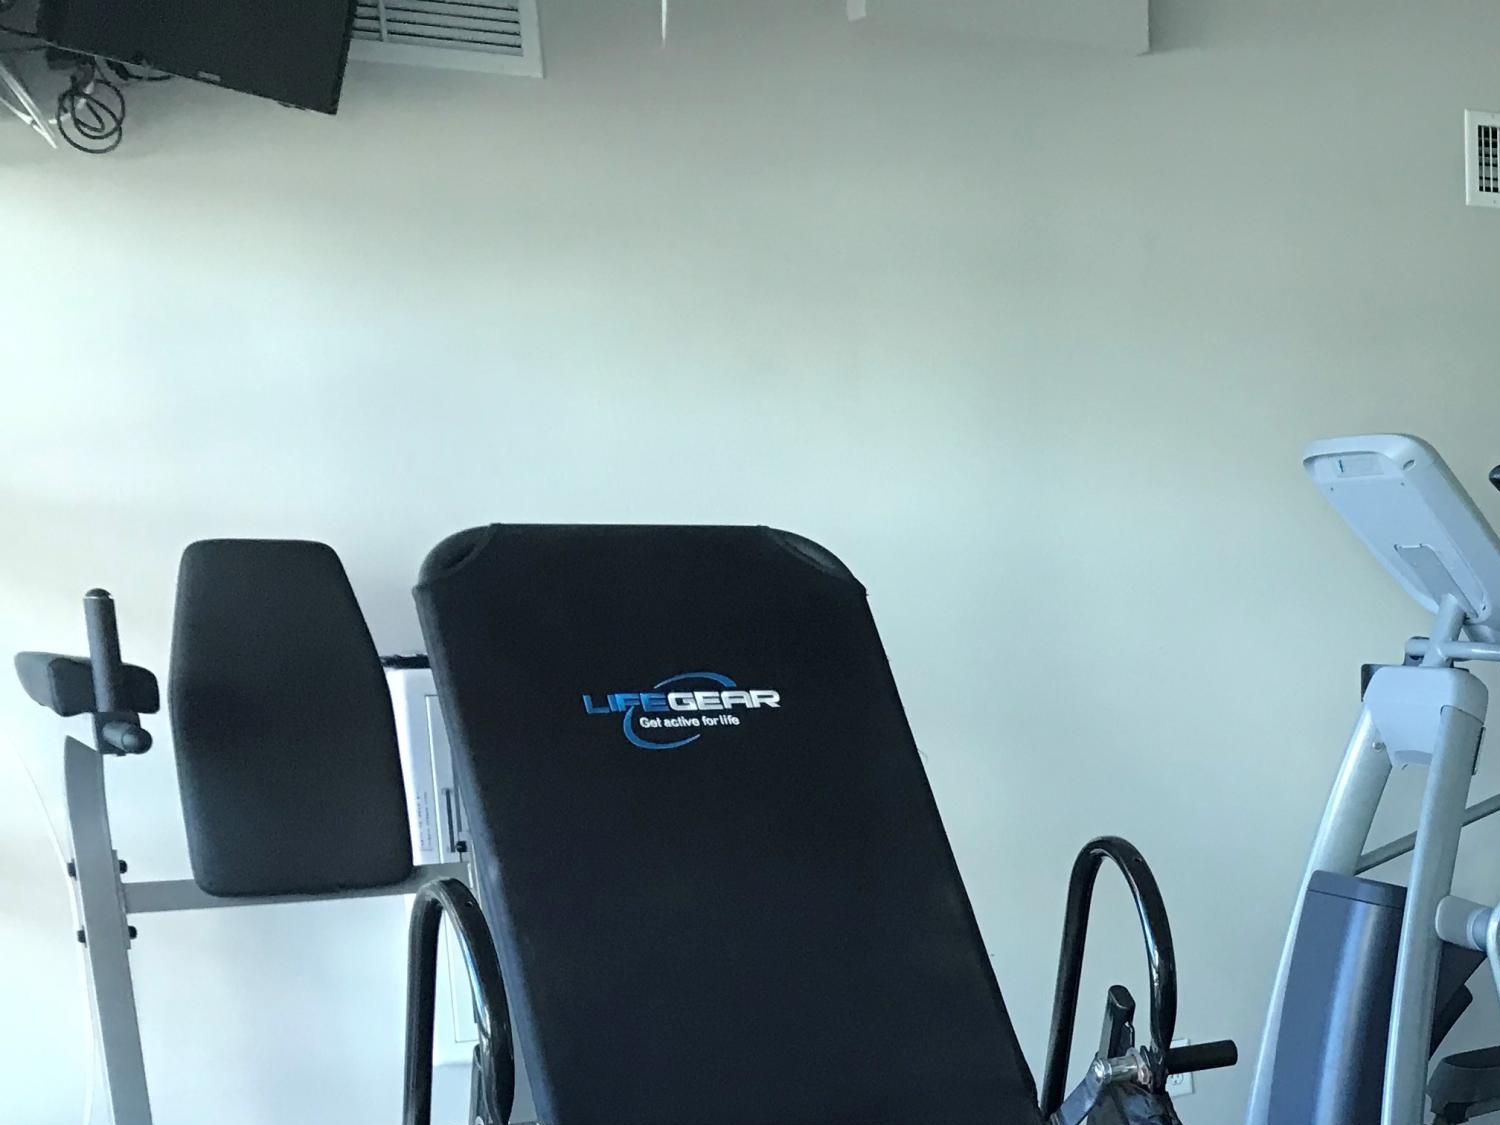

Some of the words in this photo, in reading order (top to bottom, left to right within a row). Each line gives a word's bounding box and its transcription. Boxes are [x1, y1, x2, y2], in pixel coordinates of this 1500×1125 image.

[582, 690, 781, 714] LIFEGEAR
[640, 717, 662, 728] Get
[664, 717, 700, 728] active
[702, 716, 718, 726] for
[719, 715, 740, 726] life
